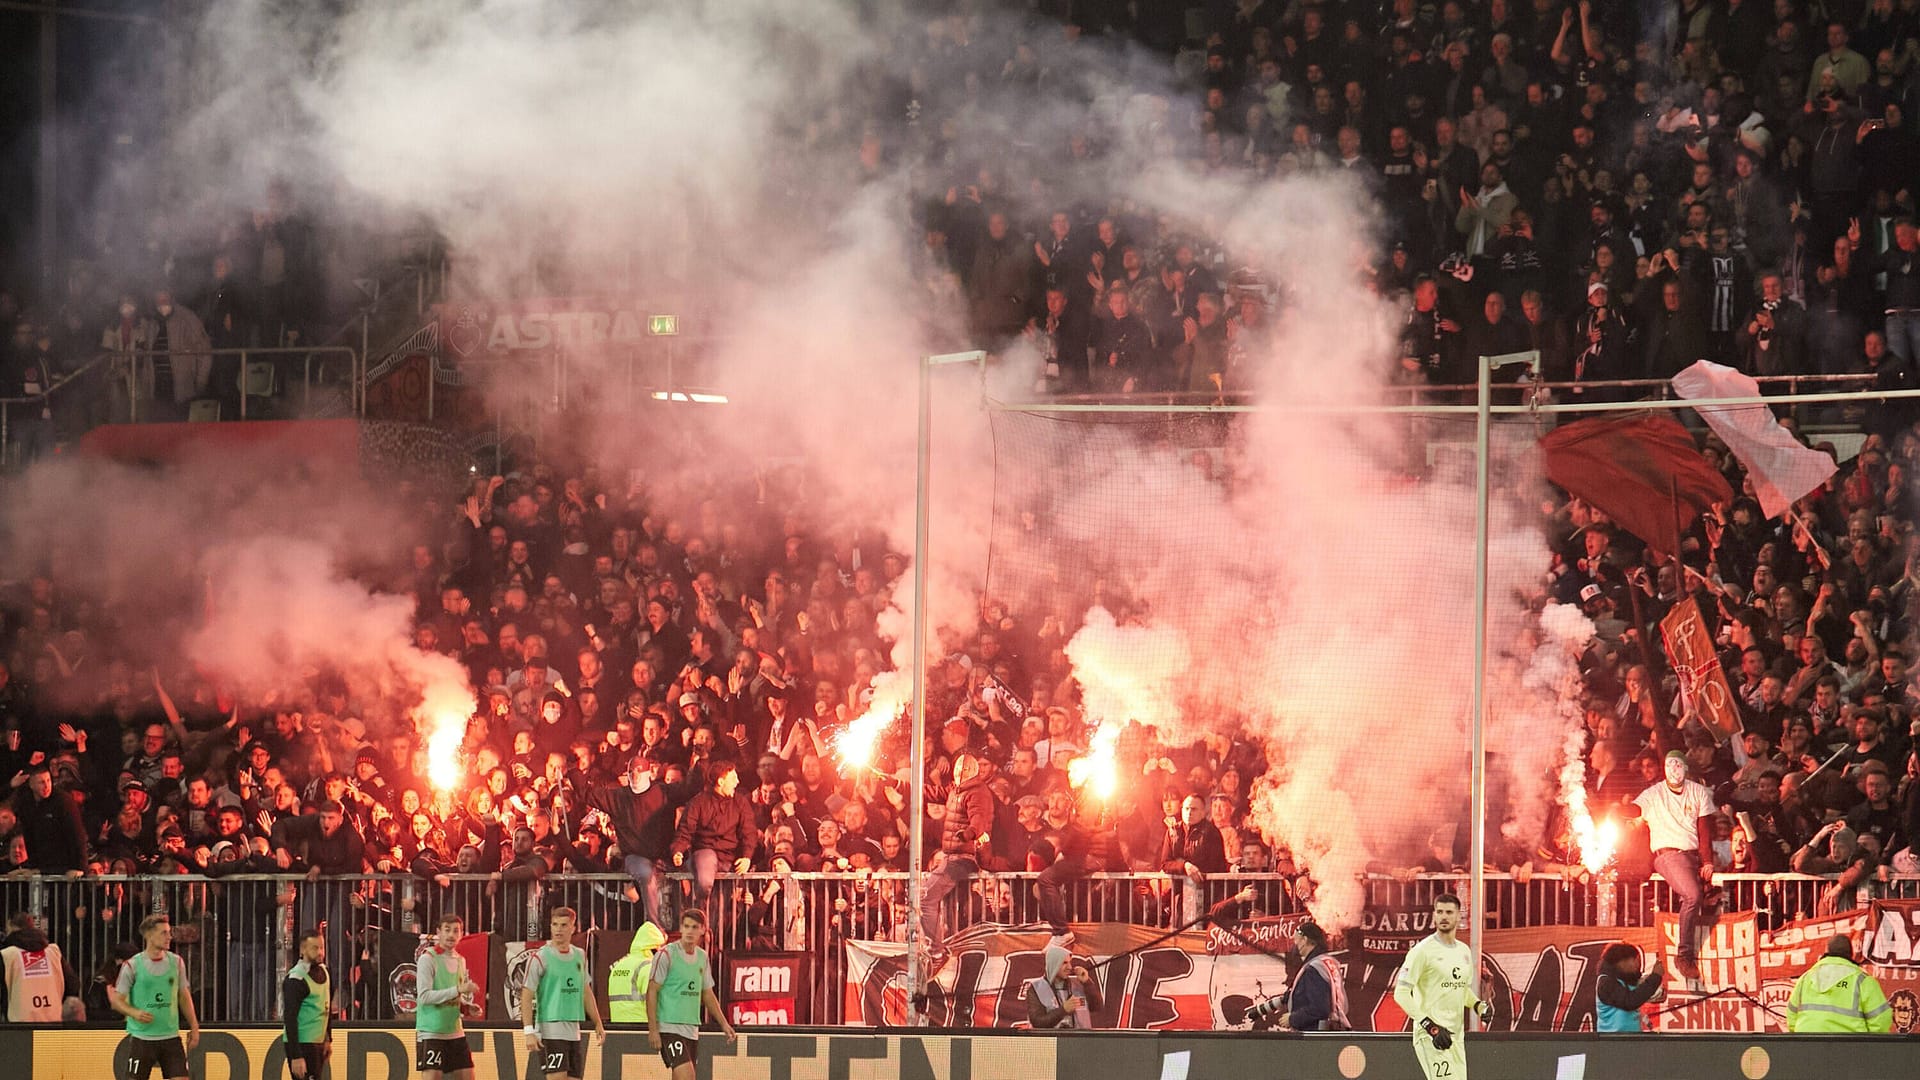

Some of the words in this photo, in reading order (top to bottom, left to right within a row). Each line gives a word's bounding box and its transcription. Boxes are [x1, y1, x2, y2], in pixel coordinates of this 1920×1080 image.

[487, 310, 641, 350] ASTRA
[1248, 917, 1295, 944] Sankt
[1663, 920, 1755, 959] YLLA
[1363, 938, 1399, 951] SANKT
[734, 966, 791, 993] ram
[1666, 955, 1757, 993] YLLA
[32, 995, 51, 1009] 01
[733, 1006, 788, 1025] tam
[1667, 998, 1755, 1032] SANKT
[426, 1050, 442, 1065] 24
[668, 1041, 684, 1057] 19
[128, 1057, 140, 1074] 11
[548, 1053, 564, 1069] 27
[1433, 1061, 1452, 1077] 22
